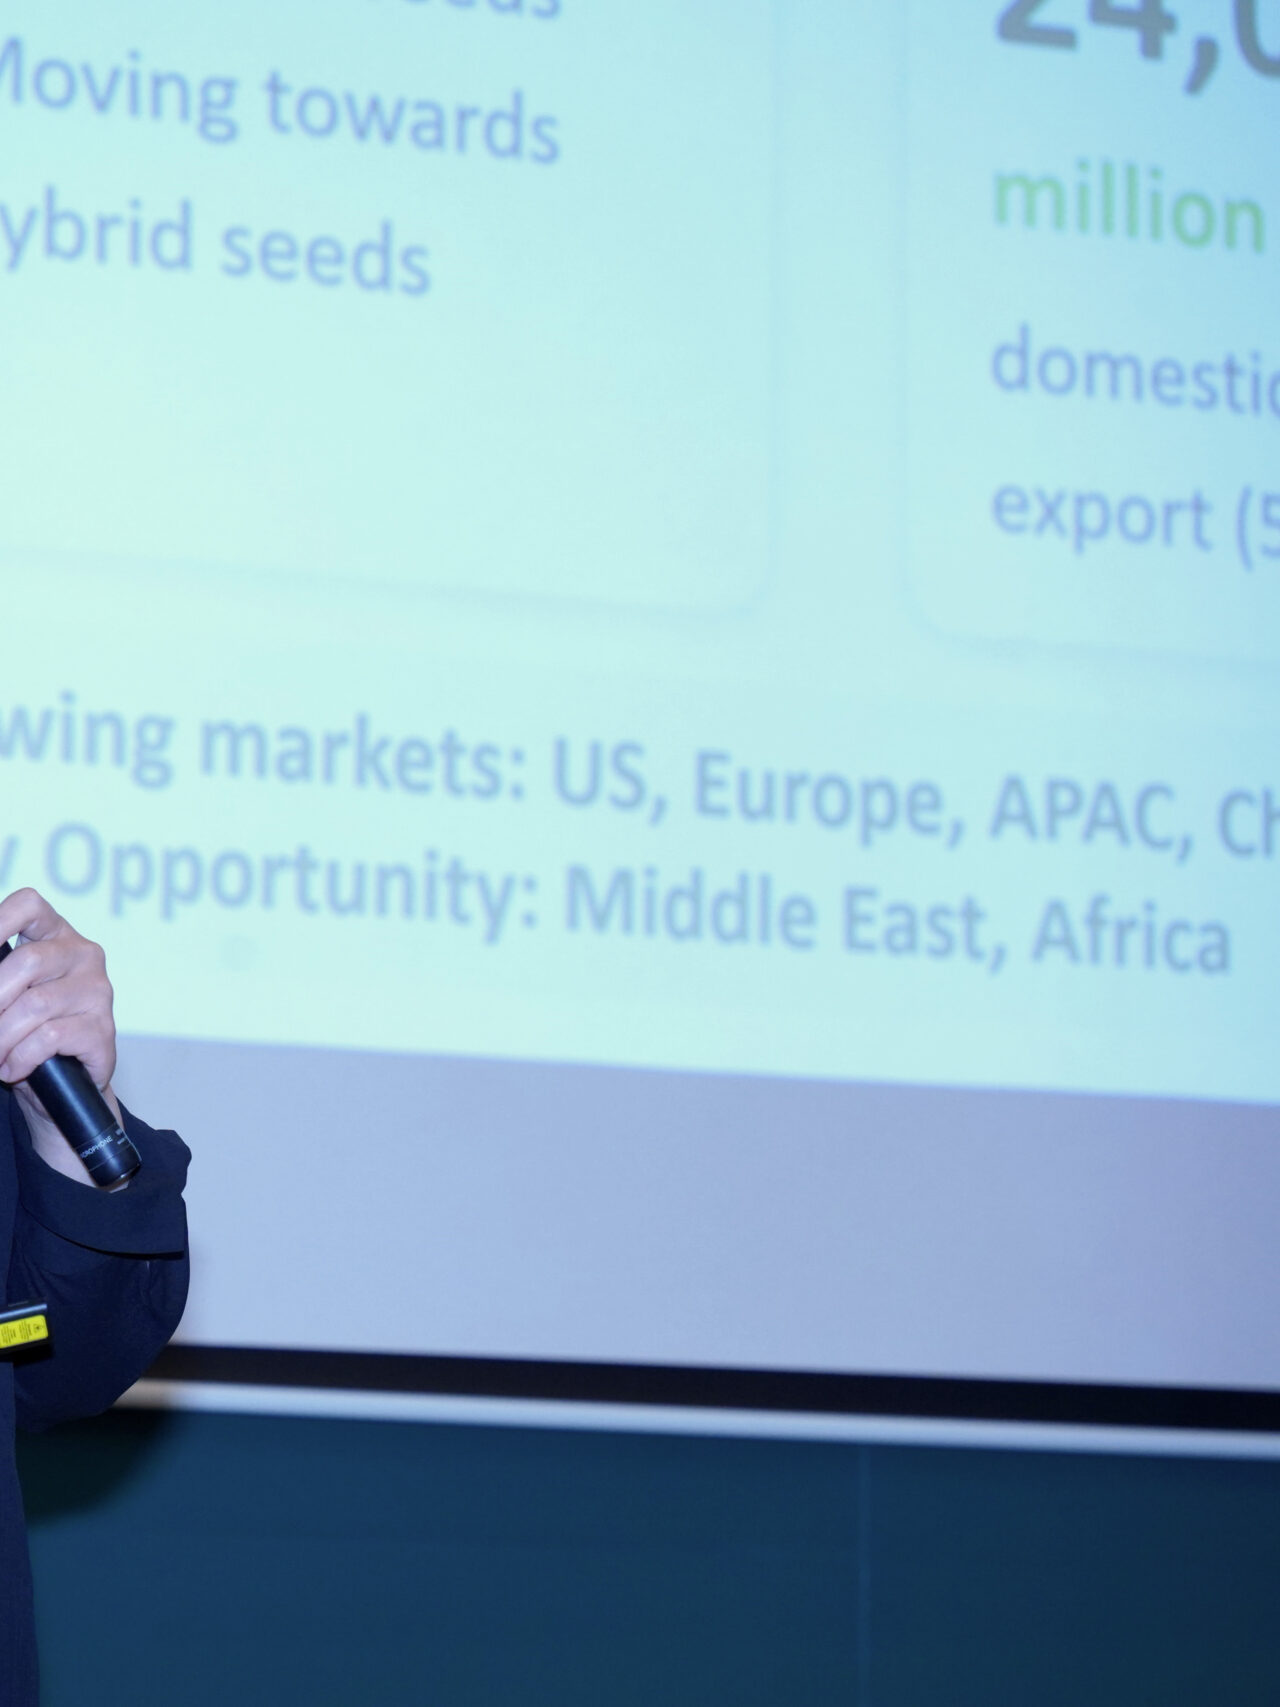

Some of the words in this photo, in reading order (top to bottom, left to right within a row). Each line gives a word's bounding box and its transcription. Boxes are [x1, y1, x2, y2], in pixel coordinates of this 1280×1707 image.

[263, 70, 561, 165] towards
[994, 158, 1266, 254] million
[222, 218, 432, 297] seeds
[991, 484, 1215, 557] export
[201, 712, 525, 801] markets:
[554, 736, 669, 827] US,
[695, 749, 965, 850] Europe,
[990, 774, 1194, 866] APAC,
[44, 822, 537, 945] Opportunity:
[567, 863, 818, 951] Middle
[844, 885, 1007, 975] East,
[1032, 892, 1234, 976] Africa
